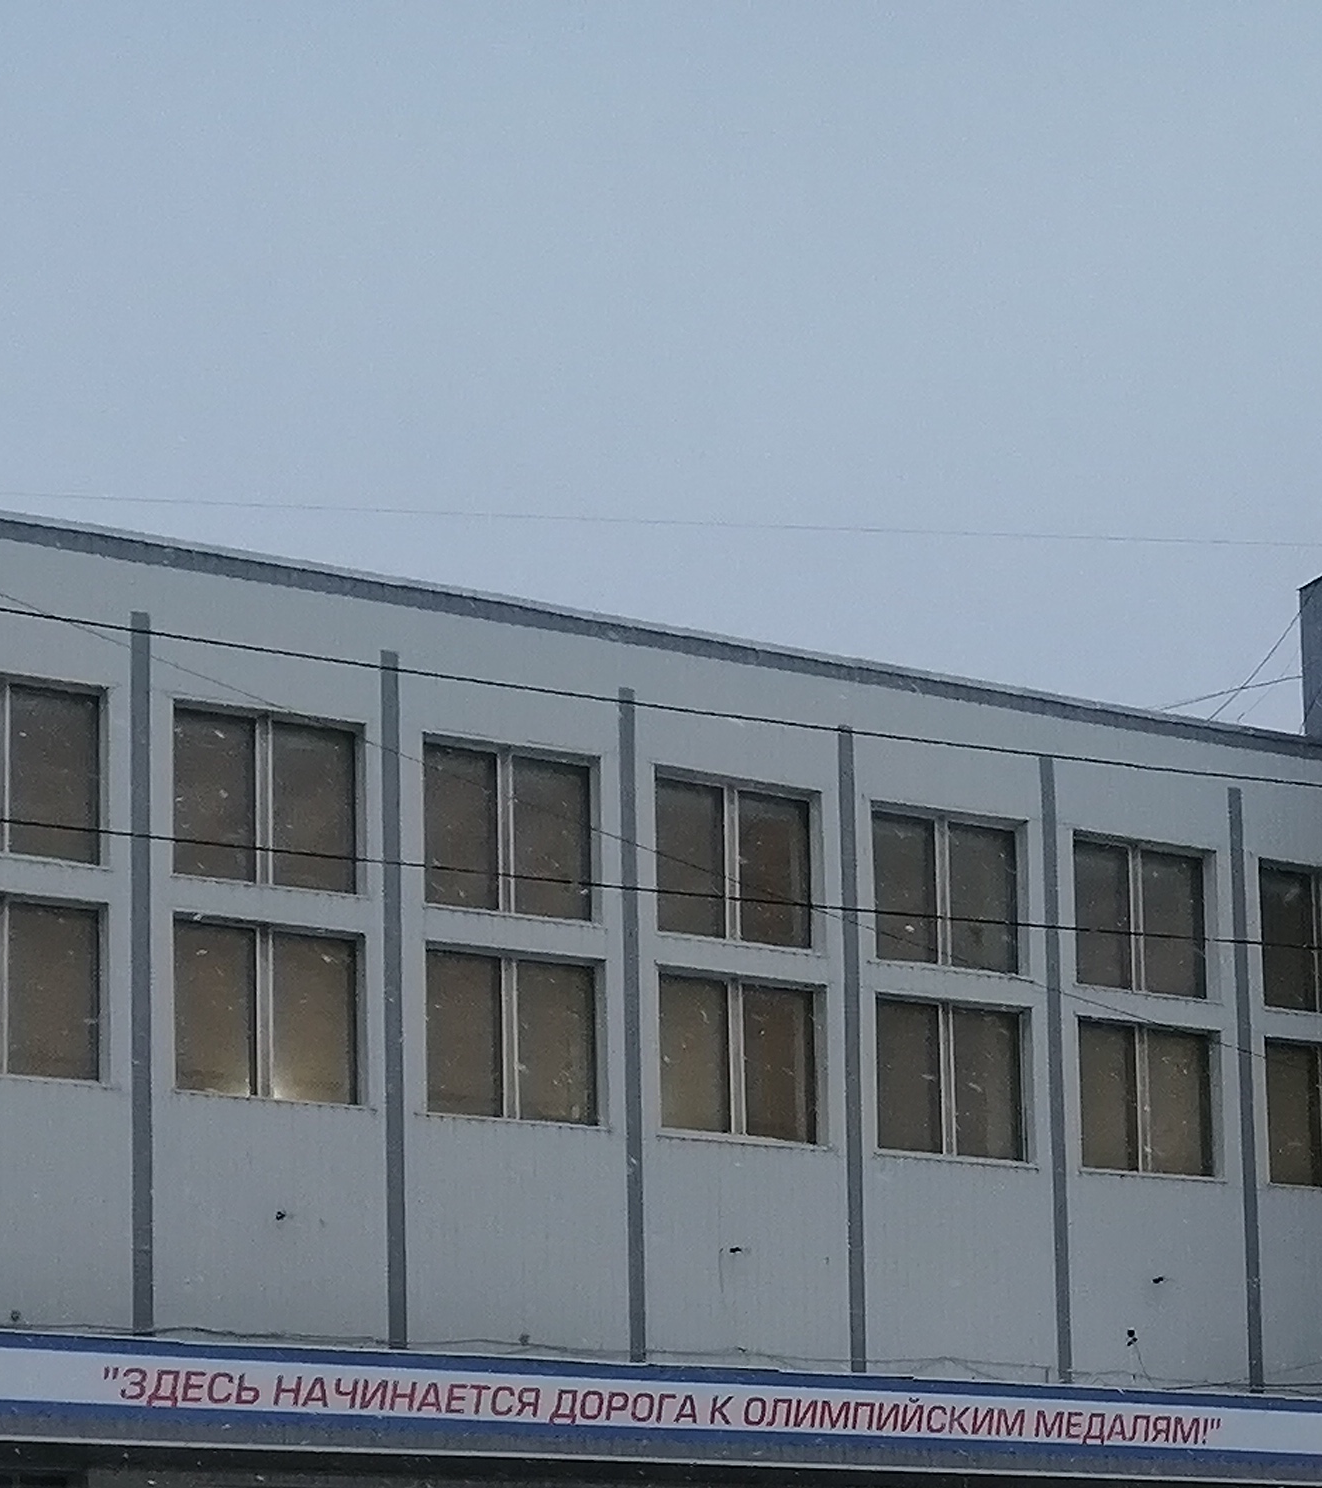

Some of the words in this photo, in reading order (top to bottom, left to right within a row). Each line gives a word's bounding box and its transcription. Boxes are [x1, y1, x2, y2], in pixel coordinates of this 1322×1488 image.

[102, 1365, 261, 1409] "ЗДЕСЬ
[272, 1373, 542, 1418] НАЧИНАЕТСЯ
[548, 1388, 698, 1426] ДОРОГА
[708, 1394, 735, 1426] К
[742, 1396, 1025, 1438] ОЛИМПИЙСКИМ
[1033, 1409, 1223, 1446] МЕДАЛЯМ!"
